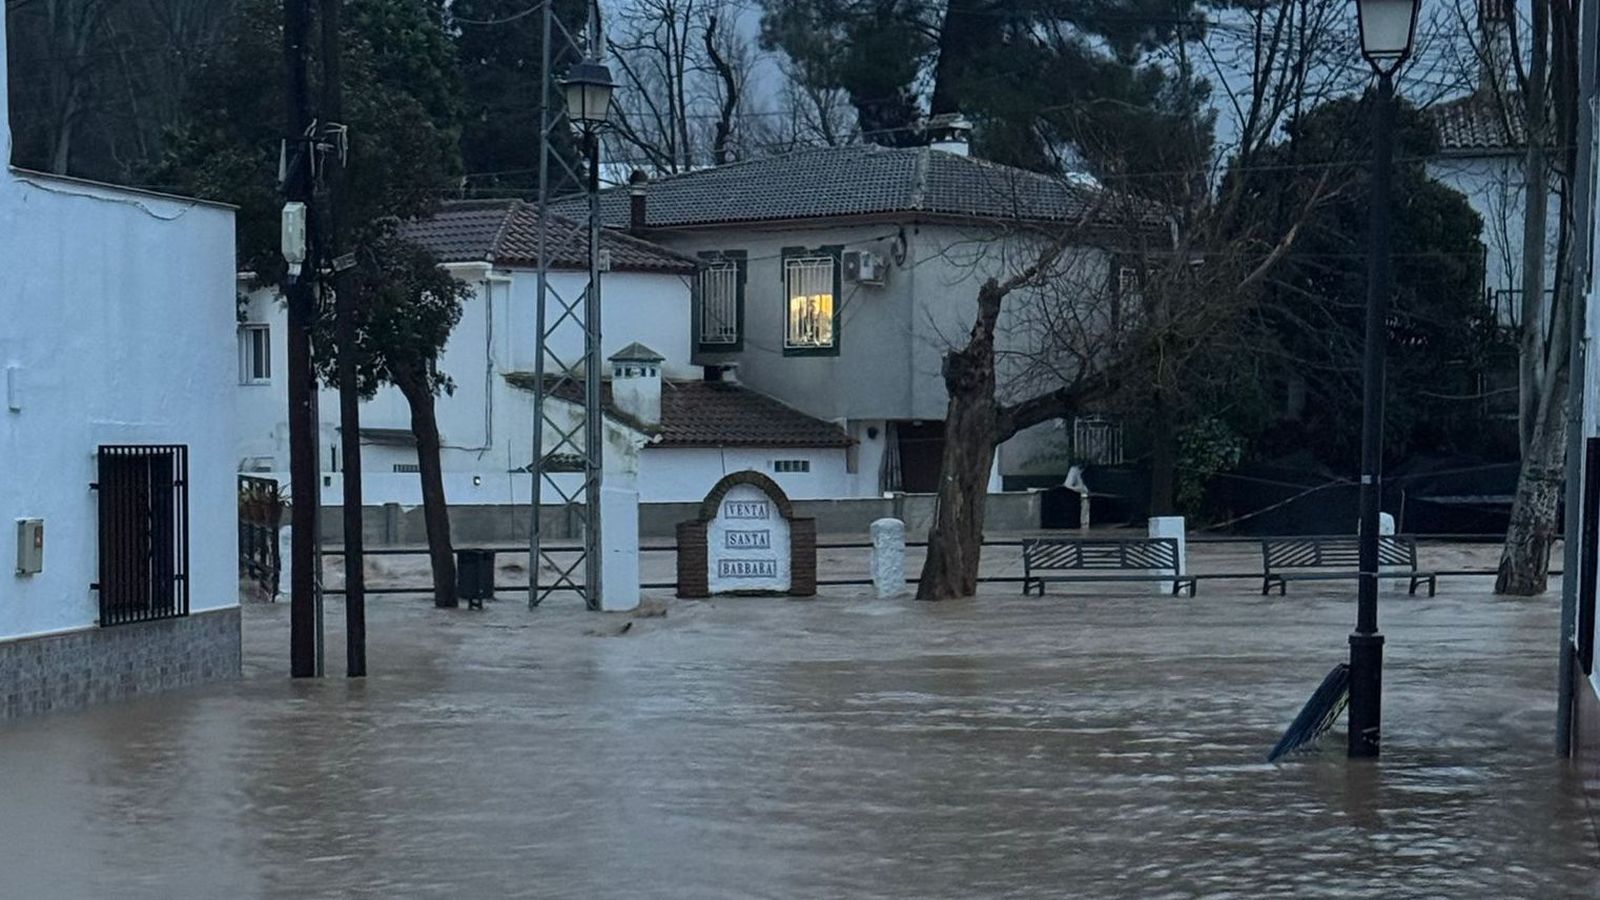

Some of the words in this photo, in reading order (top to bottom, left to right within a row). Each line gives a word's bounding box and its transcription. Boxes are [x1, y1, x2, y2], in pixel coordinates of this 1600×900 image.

[729, 504, 765, 515] VENTA
[729, 533, 766, 545] SANTA
[723, 563, 773, 574] BARBARA
